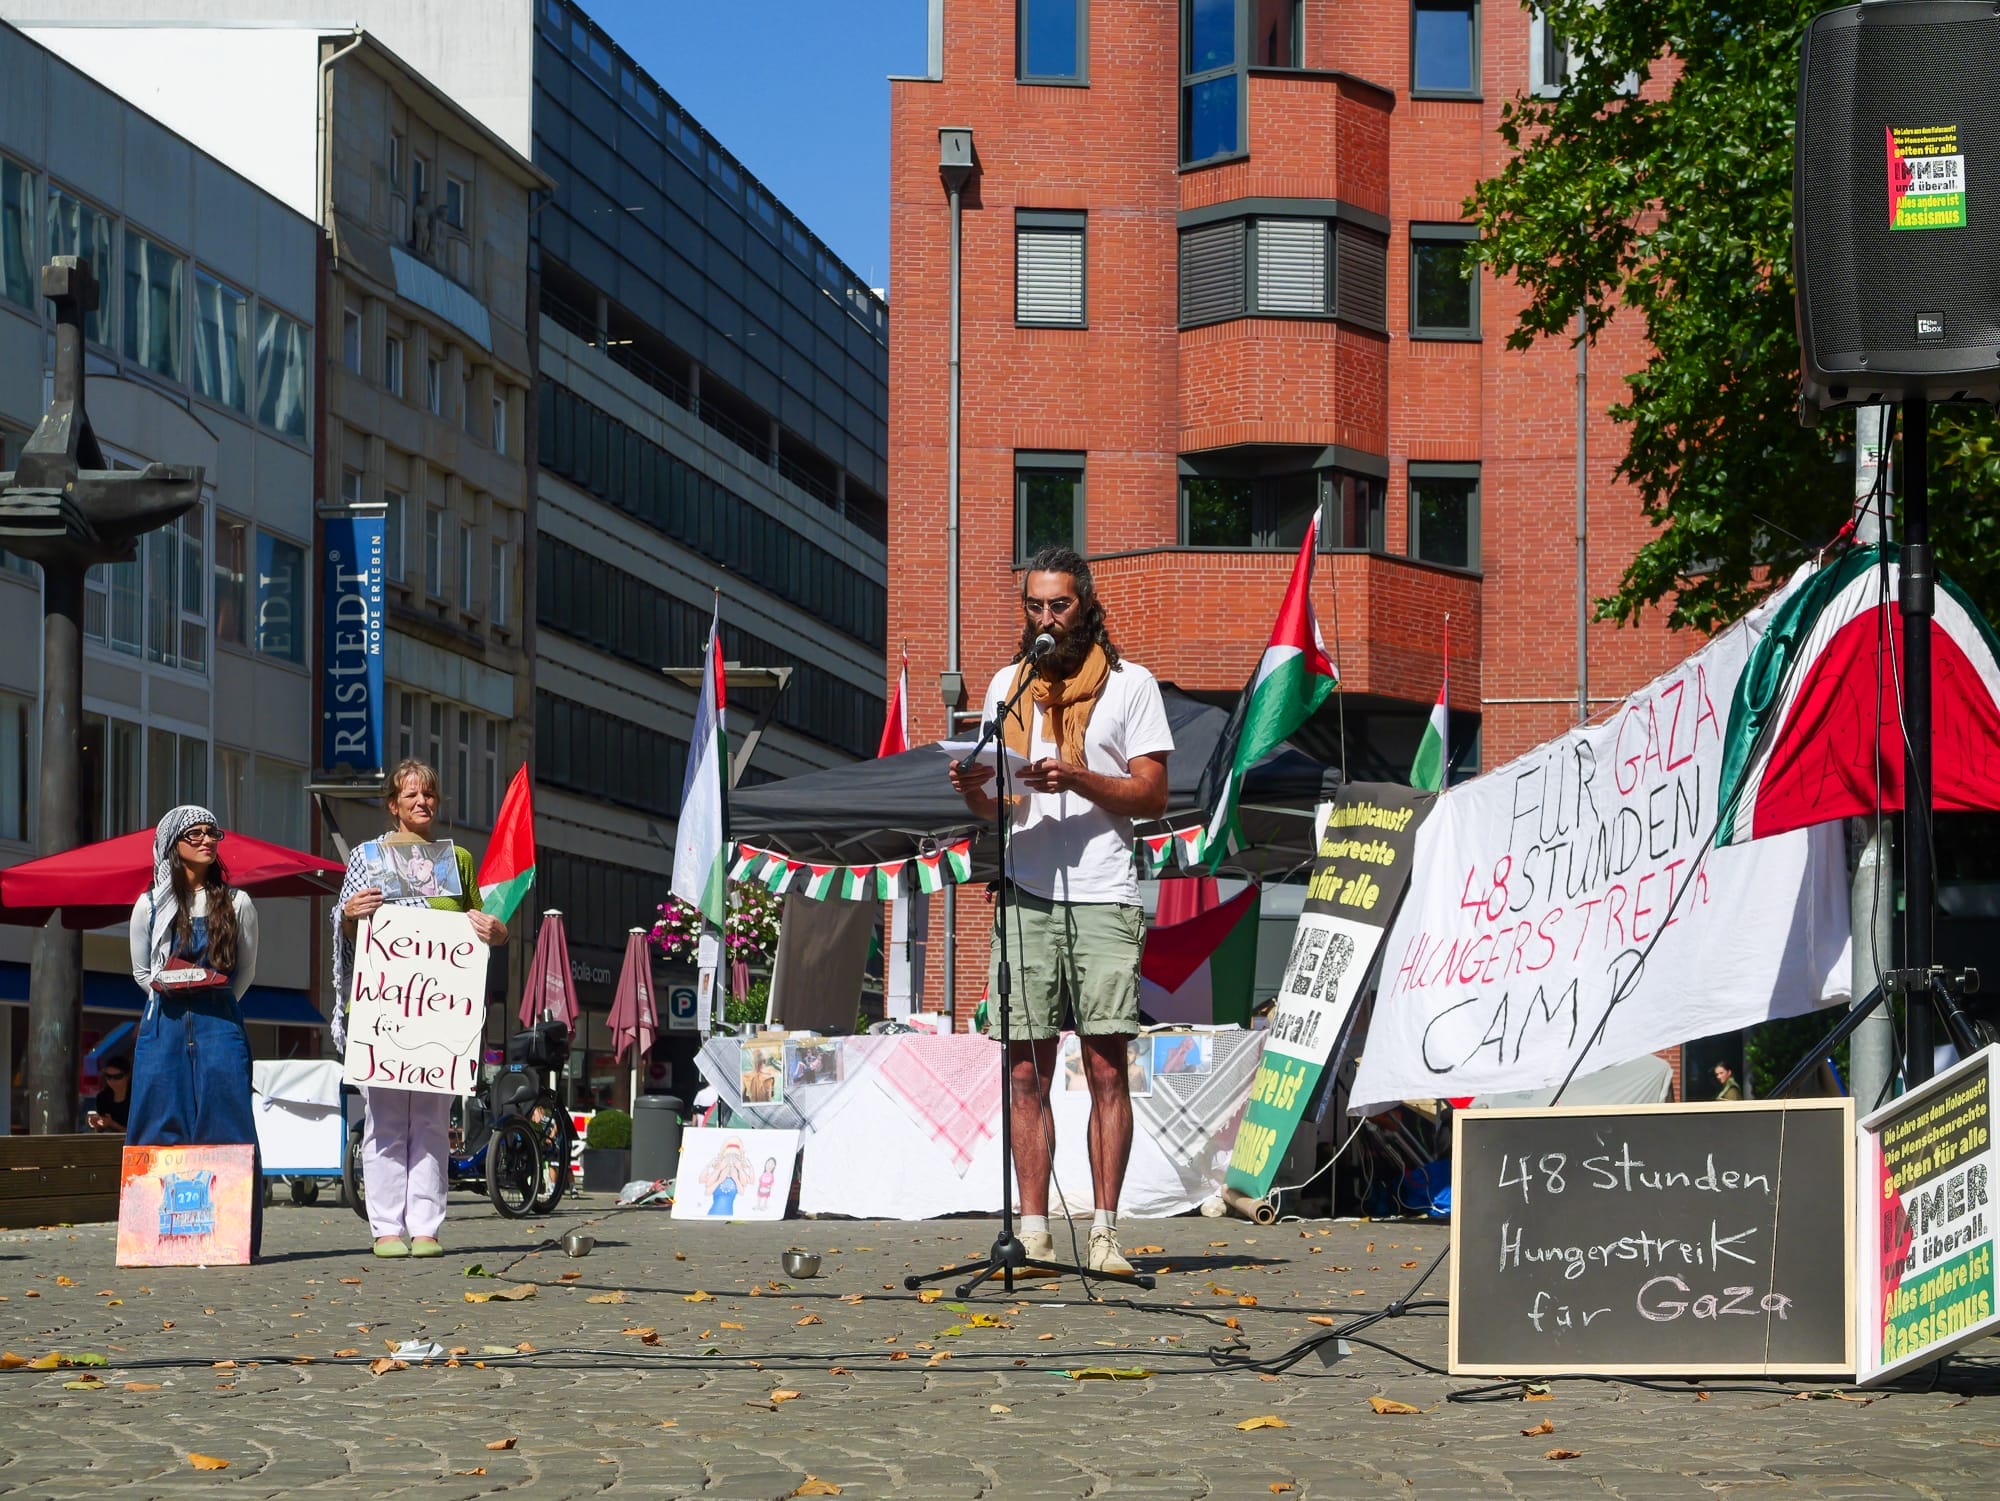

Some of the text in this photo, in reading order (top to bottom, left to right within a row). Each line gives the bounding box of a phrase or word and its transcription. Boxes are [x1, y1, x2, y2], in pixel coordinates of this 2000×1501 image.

[1894, 144, 1958, 158] gelten für alle
[1894, 160, 1958, 180] IMMER
[1896, 182, 1915, 192] und
[1896, 194, 1960, 209] Alles andere ist
[1896, 208, 1960, 226] Rassismus
[371, 535, 381, 655] MODE ERLEBEN
[1507, 663, 1720, 852] FÜR GAZA
[1459, 764, 1700, 927] 48 STUNDEN
[1339, 873, 1380, 910] alle
[365, 919, 474, 969] Keine
[355, 971, 472, 1018] Waffen
[1421, 948, 1646, 1074] CAMP
[1273, 1060, 1306, 1111] ist
[1884, 1078, 1986, 1146] Die Lehre aus dem Holocaust?
[1884, 1103, 1987, 1168] Die Menschenrechte
[1884, 1126, 1988, 1200] gelten für alle
[177, 1192, 200, 1204] 270
[1498, 1141, 1772, 1204] 48 Stunden
[1884, 1163, 1989, 1253] IMMER
[1884, 1213, 1988, 1282] und überall.
[1527, 1274, 1794, 1332] für Gaza
[1884, 1246, 1990, 1322] Alles andere ist
[1884, 1289, 1990, 1364] Rassismus
